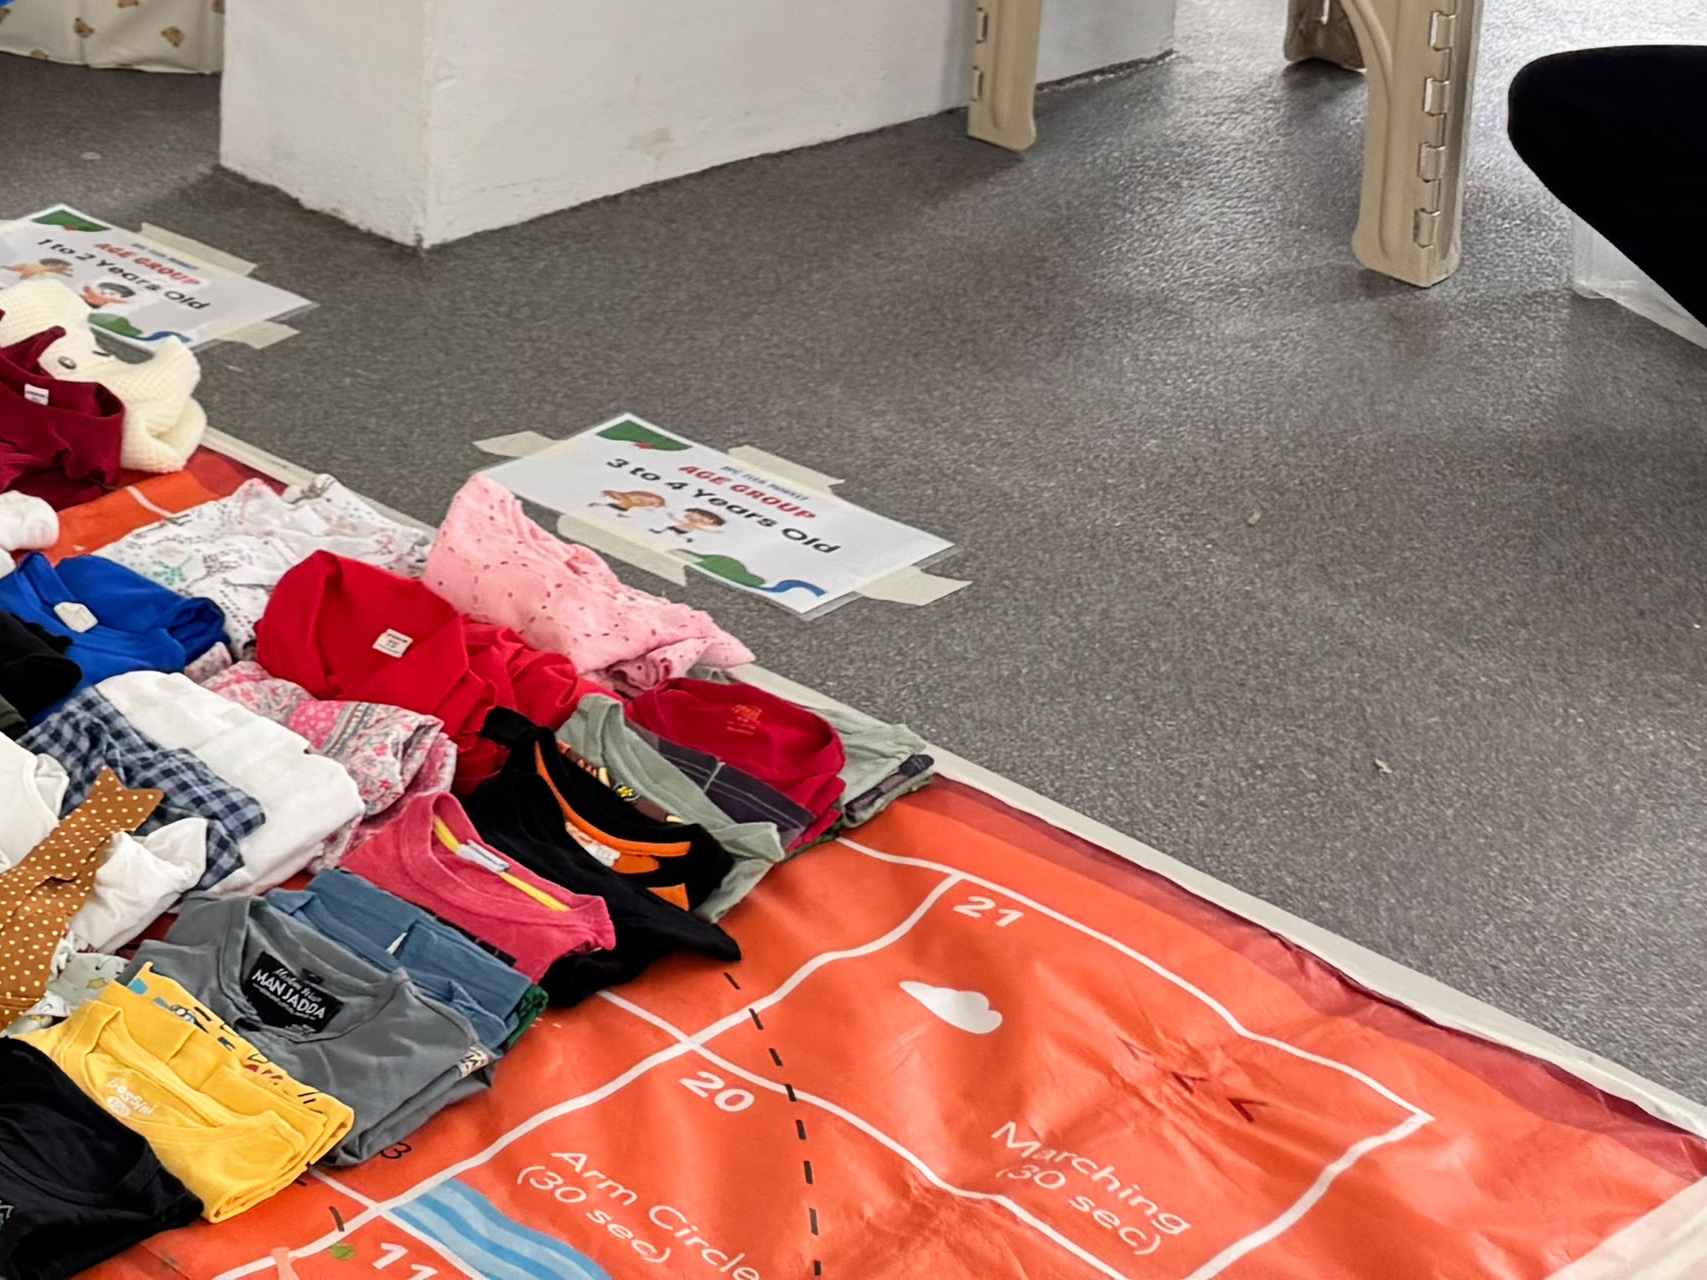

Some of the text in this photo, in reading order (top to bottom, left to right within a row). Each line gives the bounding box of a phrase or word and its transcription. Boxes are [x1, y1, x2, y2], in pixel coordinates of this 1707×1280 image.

[36, 238, 212, 310] 1 to 2 Years Old
[94, 243, 136, 259] AGE
[132, 256, 201, 286] GROUP
[606, 457, 842, 554] 3 to 4 Years Old
[678, 465, 817, 520] AGE GROUP
[951, 894, 1025, 928] 21
[251, 968, 286, 996] MAN
[283, 987, 327, 1020] JADDA
[678, 1070, 756, 1113] 20
[550, 1150, 639, 1207] Arm
[990, 1120, 1193, 1235] Marching
[516, 1164, 673, 1265] (30 sec)
[994, 1163, 1163, 1257] (30 sec)
